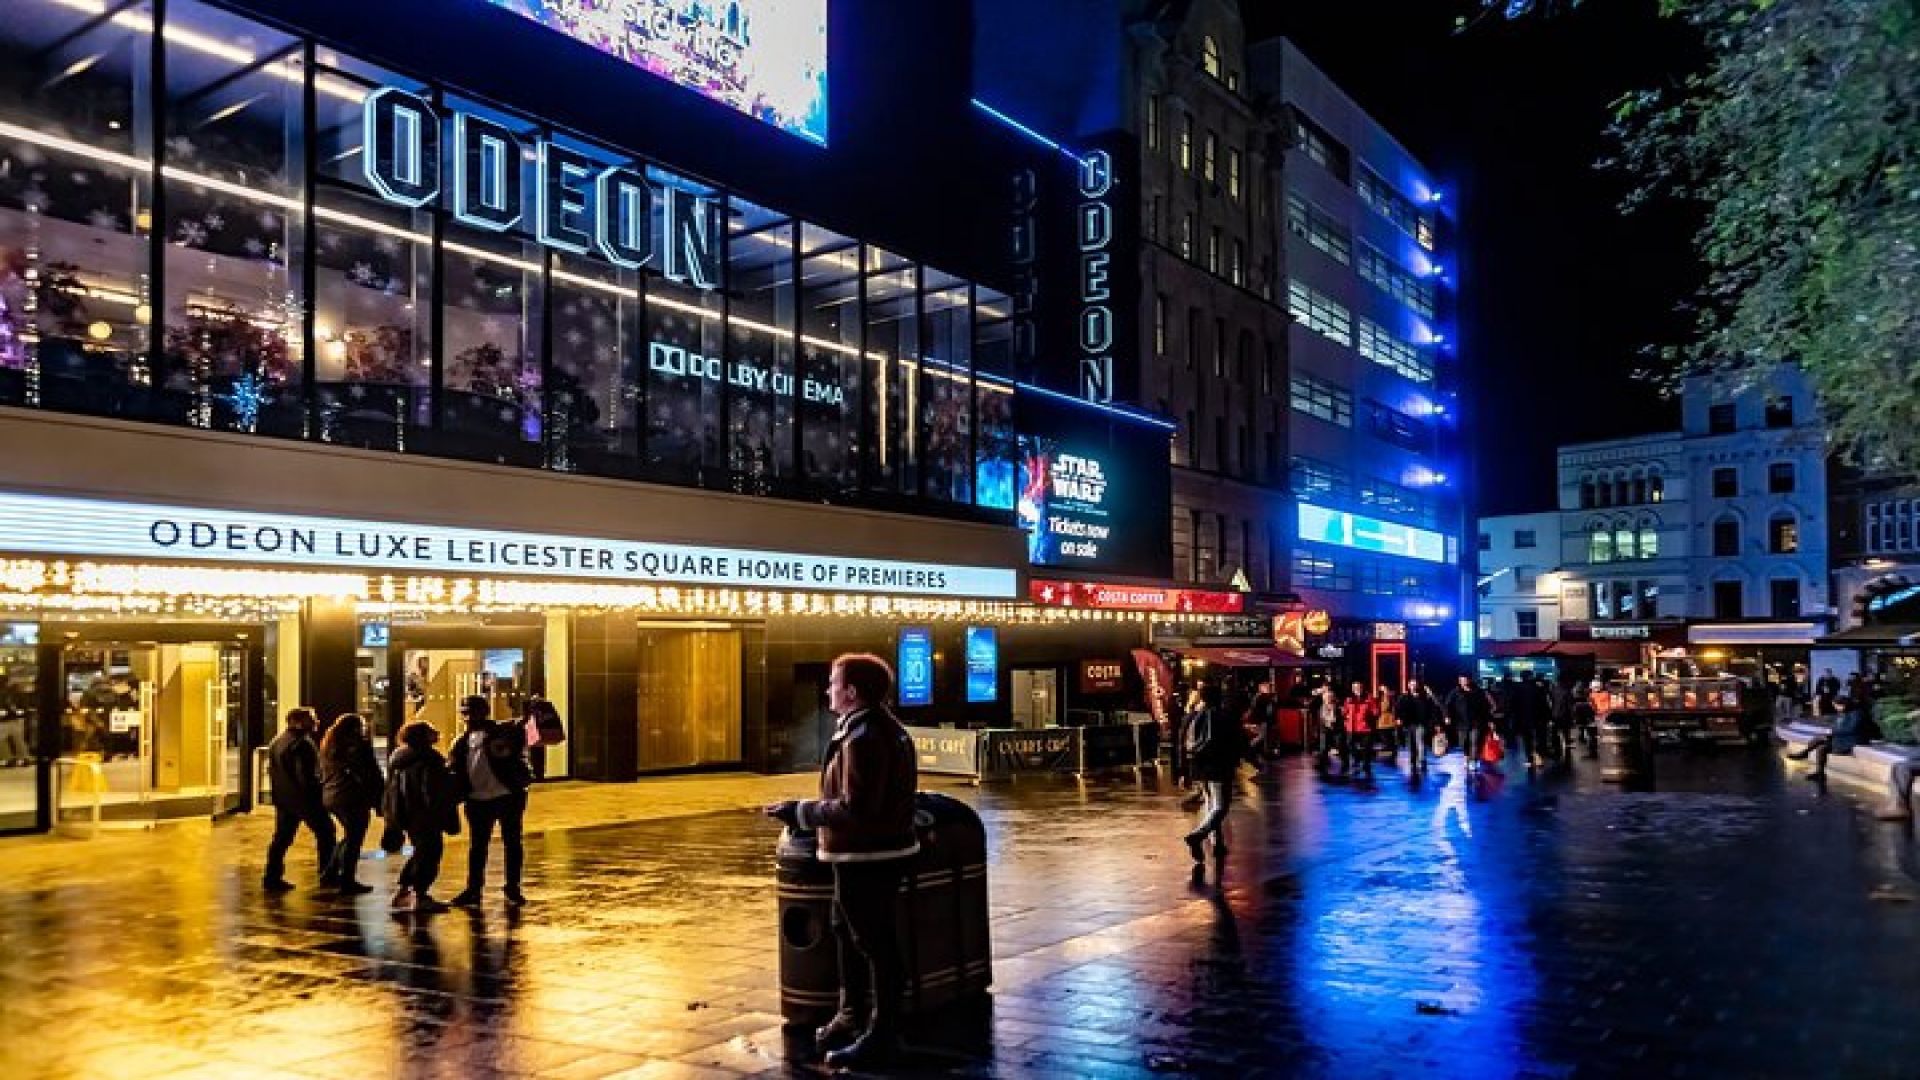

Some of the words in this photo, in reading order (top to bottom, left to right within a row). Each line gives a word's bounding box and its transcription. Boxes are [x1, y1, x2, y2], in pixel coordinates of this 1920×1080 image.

[362, 86, 721, 290] ODEON
[1079, 149, 1113, 404] ODEON
[689, 352, 768, 391] DOLBY
[772, 371, 845, 405] CIEMA
[1050, 454, 1105, 480] STAR
[1047, 517, 1086, 536] Tickets
[1087, 523, 1110, 539] now
[149, 518, 316, 555] ODEON
[335, 530, 432, 561] LUXE
[447, 538, 614, 571] LEICESTER
[624, 550, 730, 577] SQUARE
[737, 558, 804, 582] HOME
[812, 564, 839, 583] OF
[845, 566, 948, 589] PREMIERES
[1060, 542, 1076, 555] on
[1076, 540, 1097, 558] sale
[1098, 589, 1129, 604] COSTA
[1087, 665, 1121, 679] COSTA
